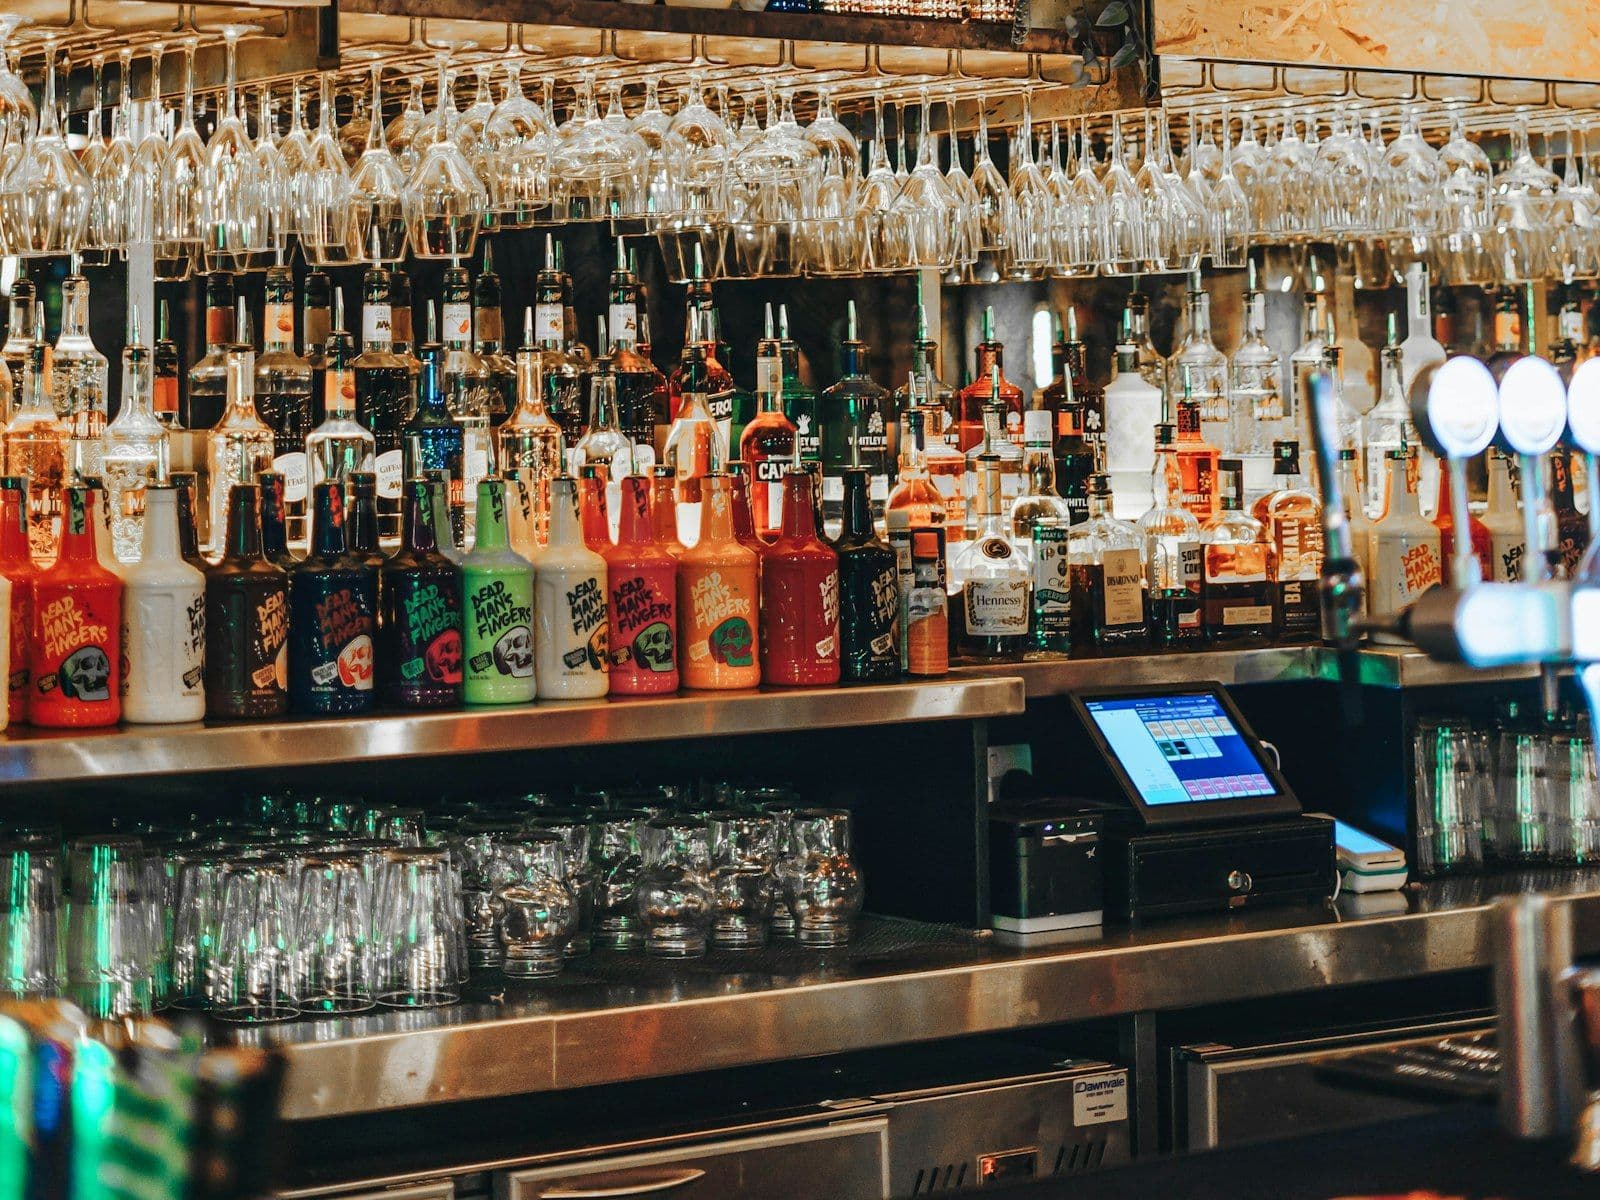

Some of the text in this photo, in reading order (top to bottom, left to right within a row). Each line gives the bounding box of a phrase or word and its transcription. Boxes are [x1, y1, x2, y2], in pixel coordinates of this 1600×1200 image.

[379, 463, 402, 473] GIFFA
[1401, 543, 1429, 567] DEAD
[403, 584, 439, 614] DEAD
[471, 580, 505, 610] DEAD
[566, 577, 597, 606] DEAD
[613, 577, 645, 604] DEAD
[691, 571, 722, 601] DEAD
[976, 595, 1021, 607] Hennessy
[42, 596, 74, 625] DEAD
[475, 593, 513, 623] MAN'S
[618, 603, 672, 634] FINGERS
[696, 598, 751, 629] FINGERS
[43, 609, 84, 641] MAN'S
[478, 607, 531, 640] FINGERS
[45, 625, 108, 659] FINGERS
[1075, 1078, 1125, 1094] Dawnvale
